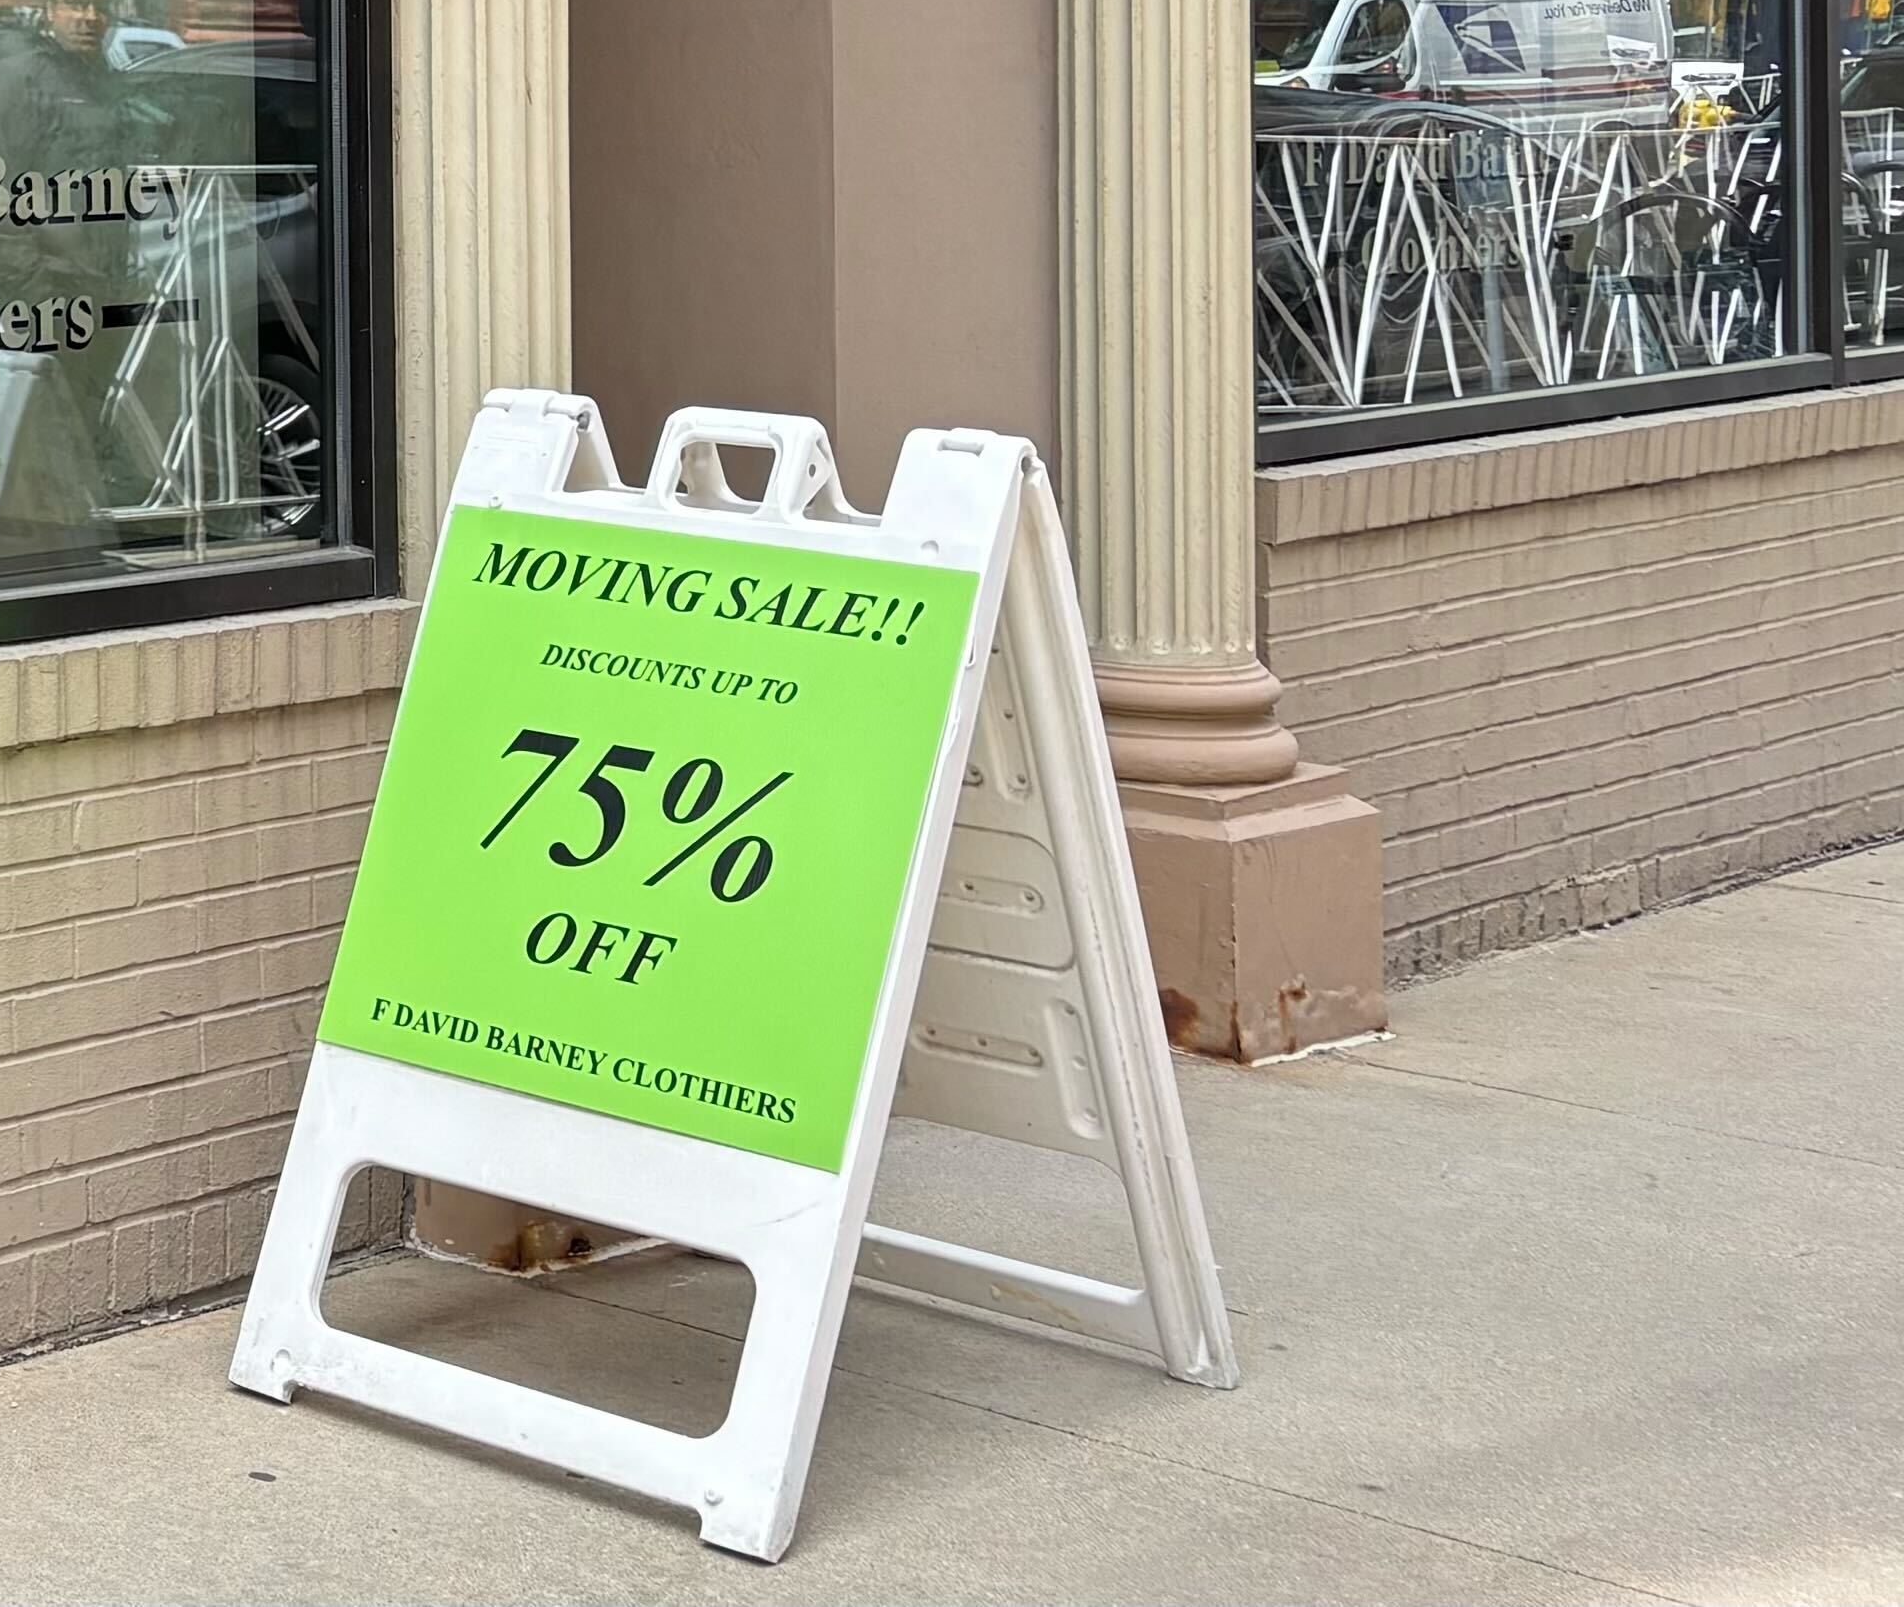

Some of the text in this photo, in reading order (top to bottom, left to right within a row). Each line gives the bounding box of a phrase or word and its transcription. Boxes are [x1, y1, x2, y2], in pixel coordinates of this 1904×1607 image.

[473, 543, 925, 646] MOVING SALE!!
[541, 643, 799, 704] DISCOUNTS UP TO
[480, 728, 794, 904] 75%
[525, 911, 678, 986] OFF
[372, 997, 797, 1125] F DAVID BARNEY CLOTHIERS
